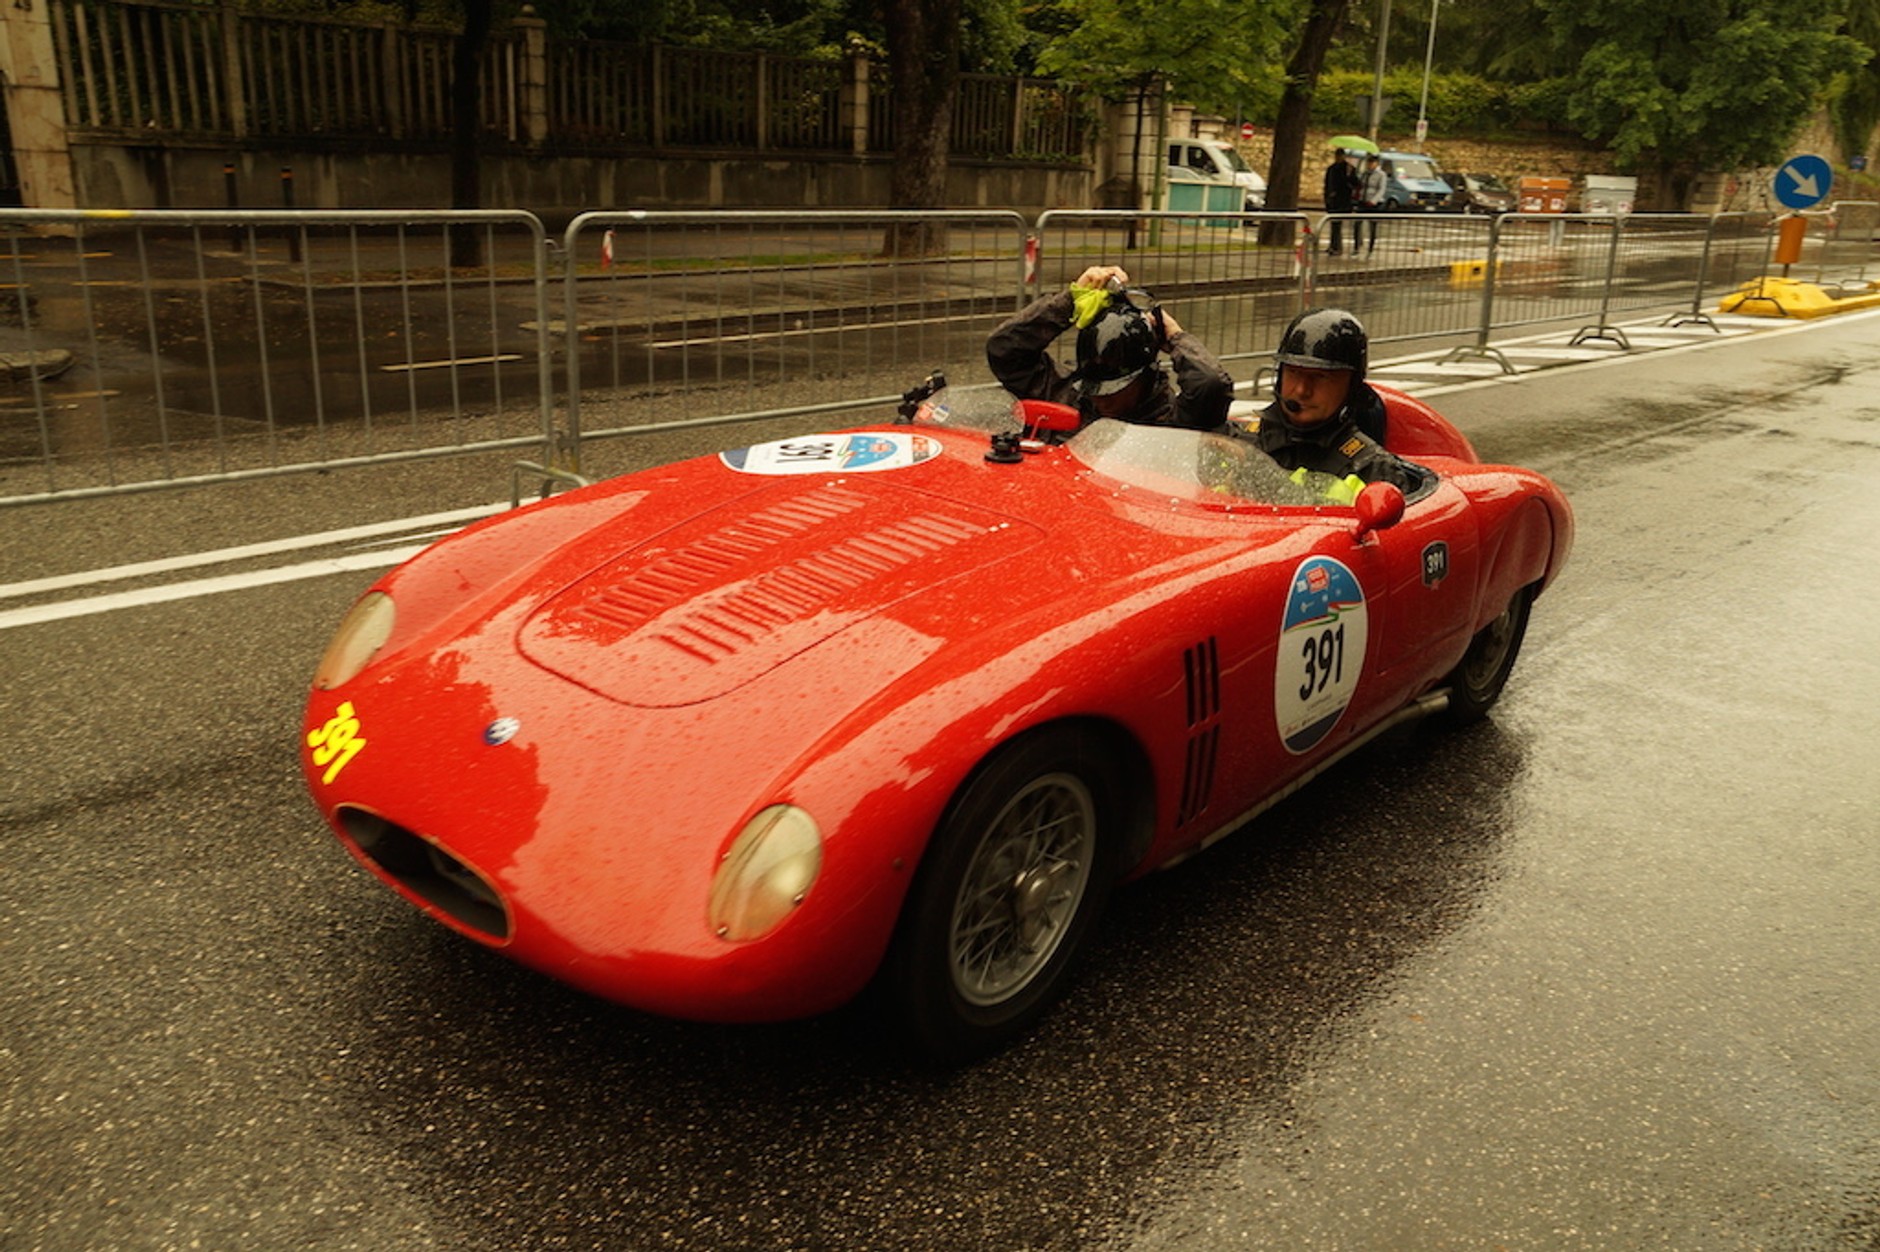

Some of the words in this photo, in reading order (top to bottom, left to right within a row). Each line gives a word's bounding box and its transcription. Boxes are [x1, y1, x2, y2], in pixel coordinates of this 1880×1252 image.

[776, 442, 834, 463] 391
[1426, 550, 1445, 574] 391
[1299, 622, 1345, 701] 391
[307, 702, 367, 784] 391
